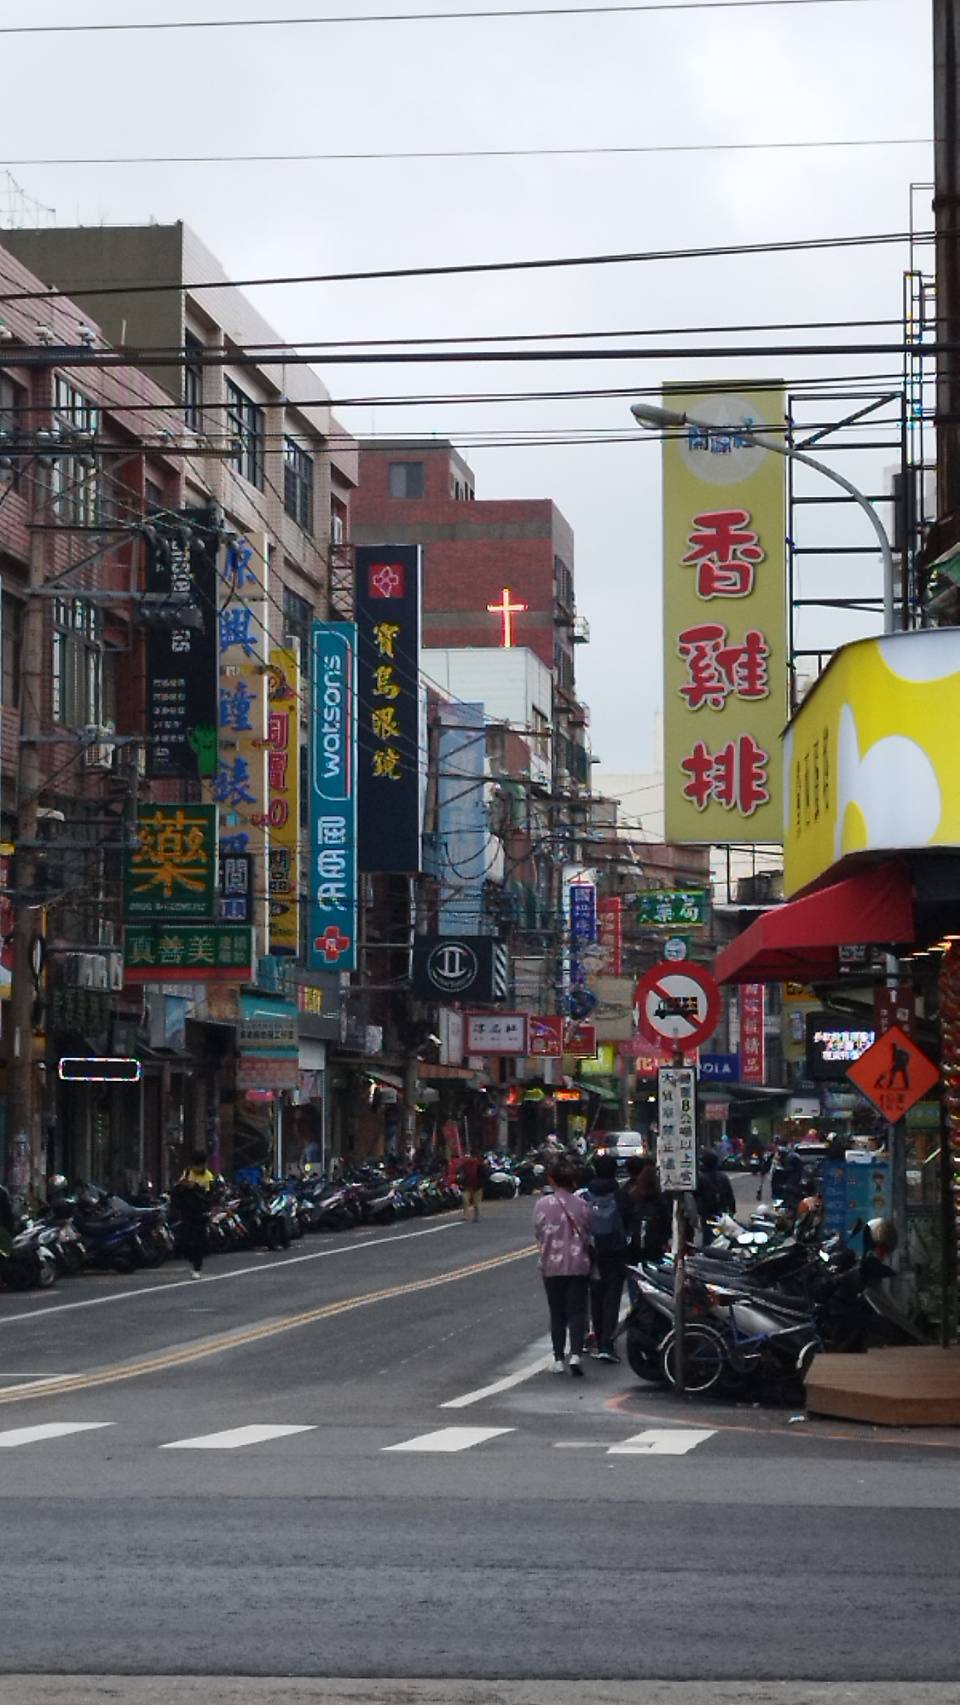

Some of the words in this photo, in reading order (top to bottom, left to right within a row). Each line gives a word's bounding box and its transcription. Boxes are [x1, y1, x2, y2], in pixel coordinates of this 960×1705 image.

[321, 654, 341, 779] watsons
[371, 620, 401, 781] 寶島眼鏡
[680, 508, 770, 817] 香雞排
[128, 809, 208, 897] 藥
[317, 815, 347, 911] 屈臣氏
[128, 936, 215, 964] 真善美
